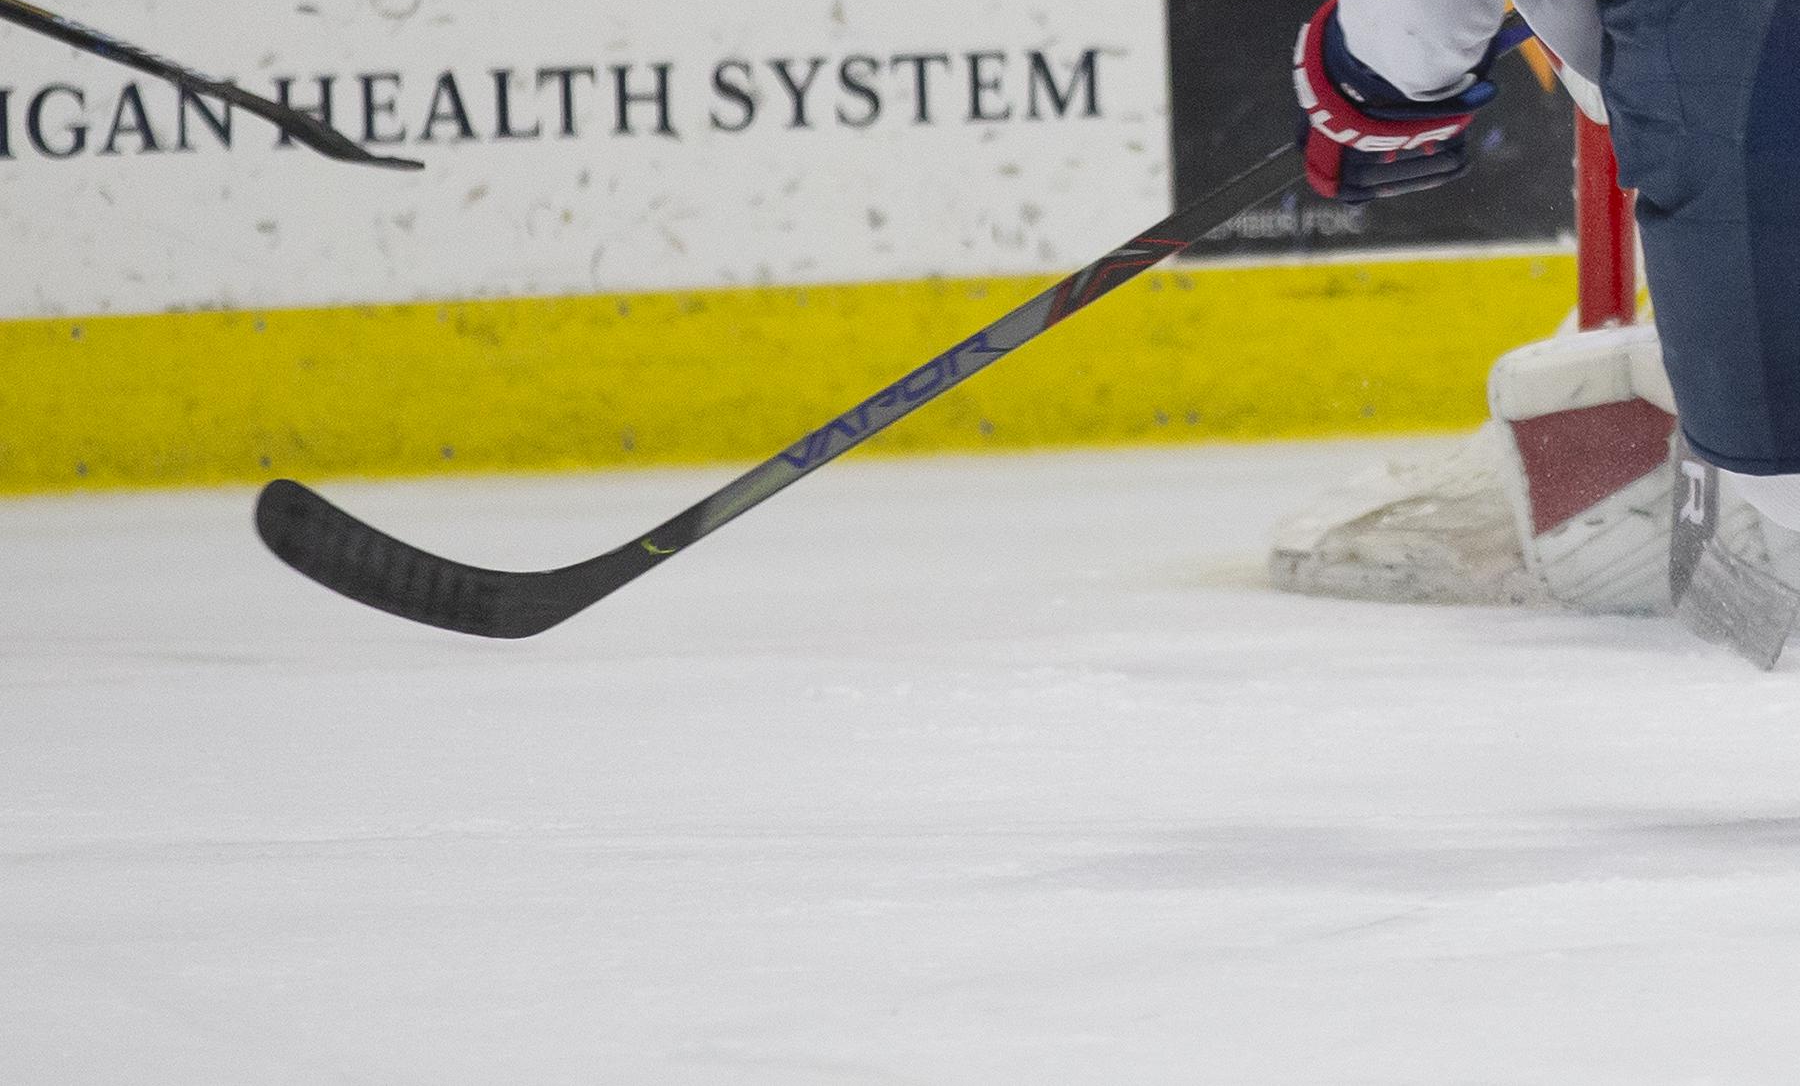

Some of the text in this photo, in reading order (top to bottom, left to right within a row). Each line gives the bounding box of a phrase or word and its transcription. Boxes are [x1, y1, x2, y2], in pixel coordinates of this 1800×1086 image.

[272, 62, 678, 151] HEALTH
[708, 48, 1106, 135] SYSTEM
[779, 332, 1012, 470] VAPOR
